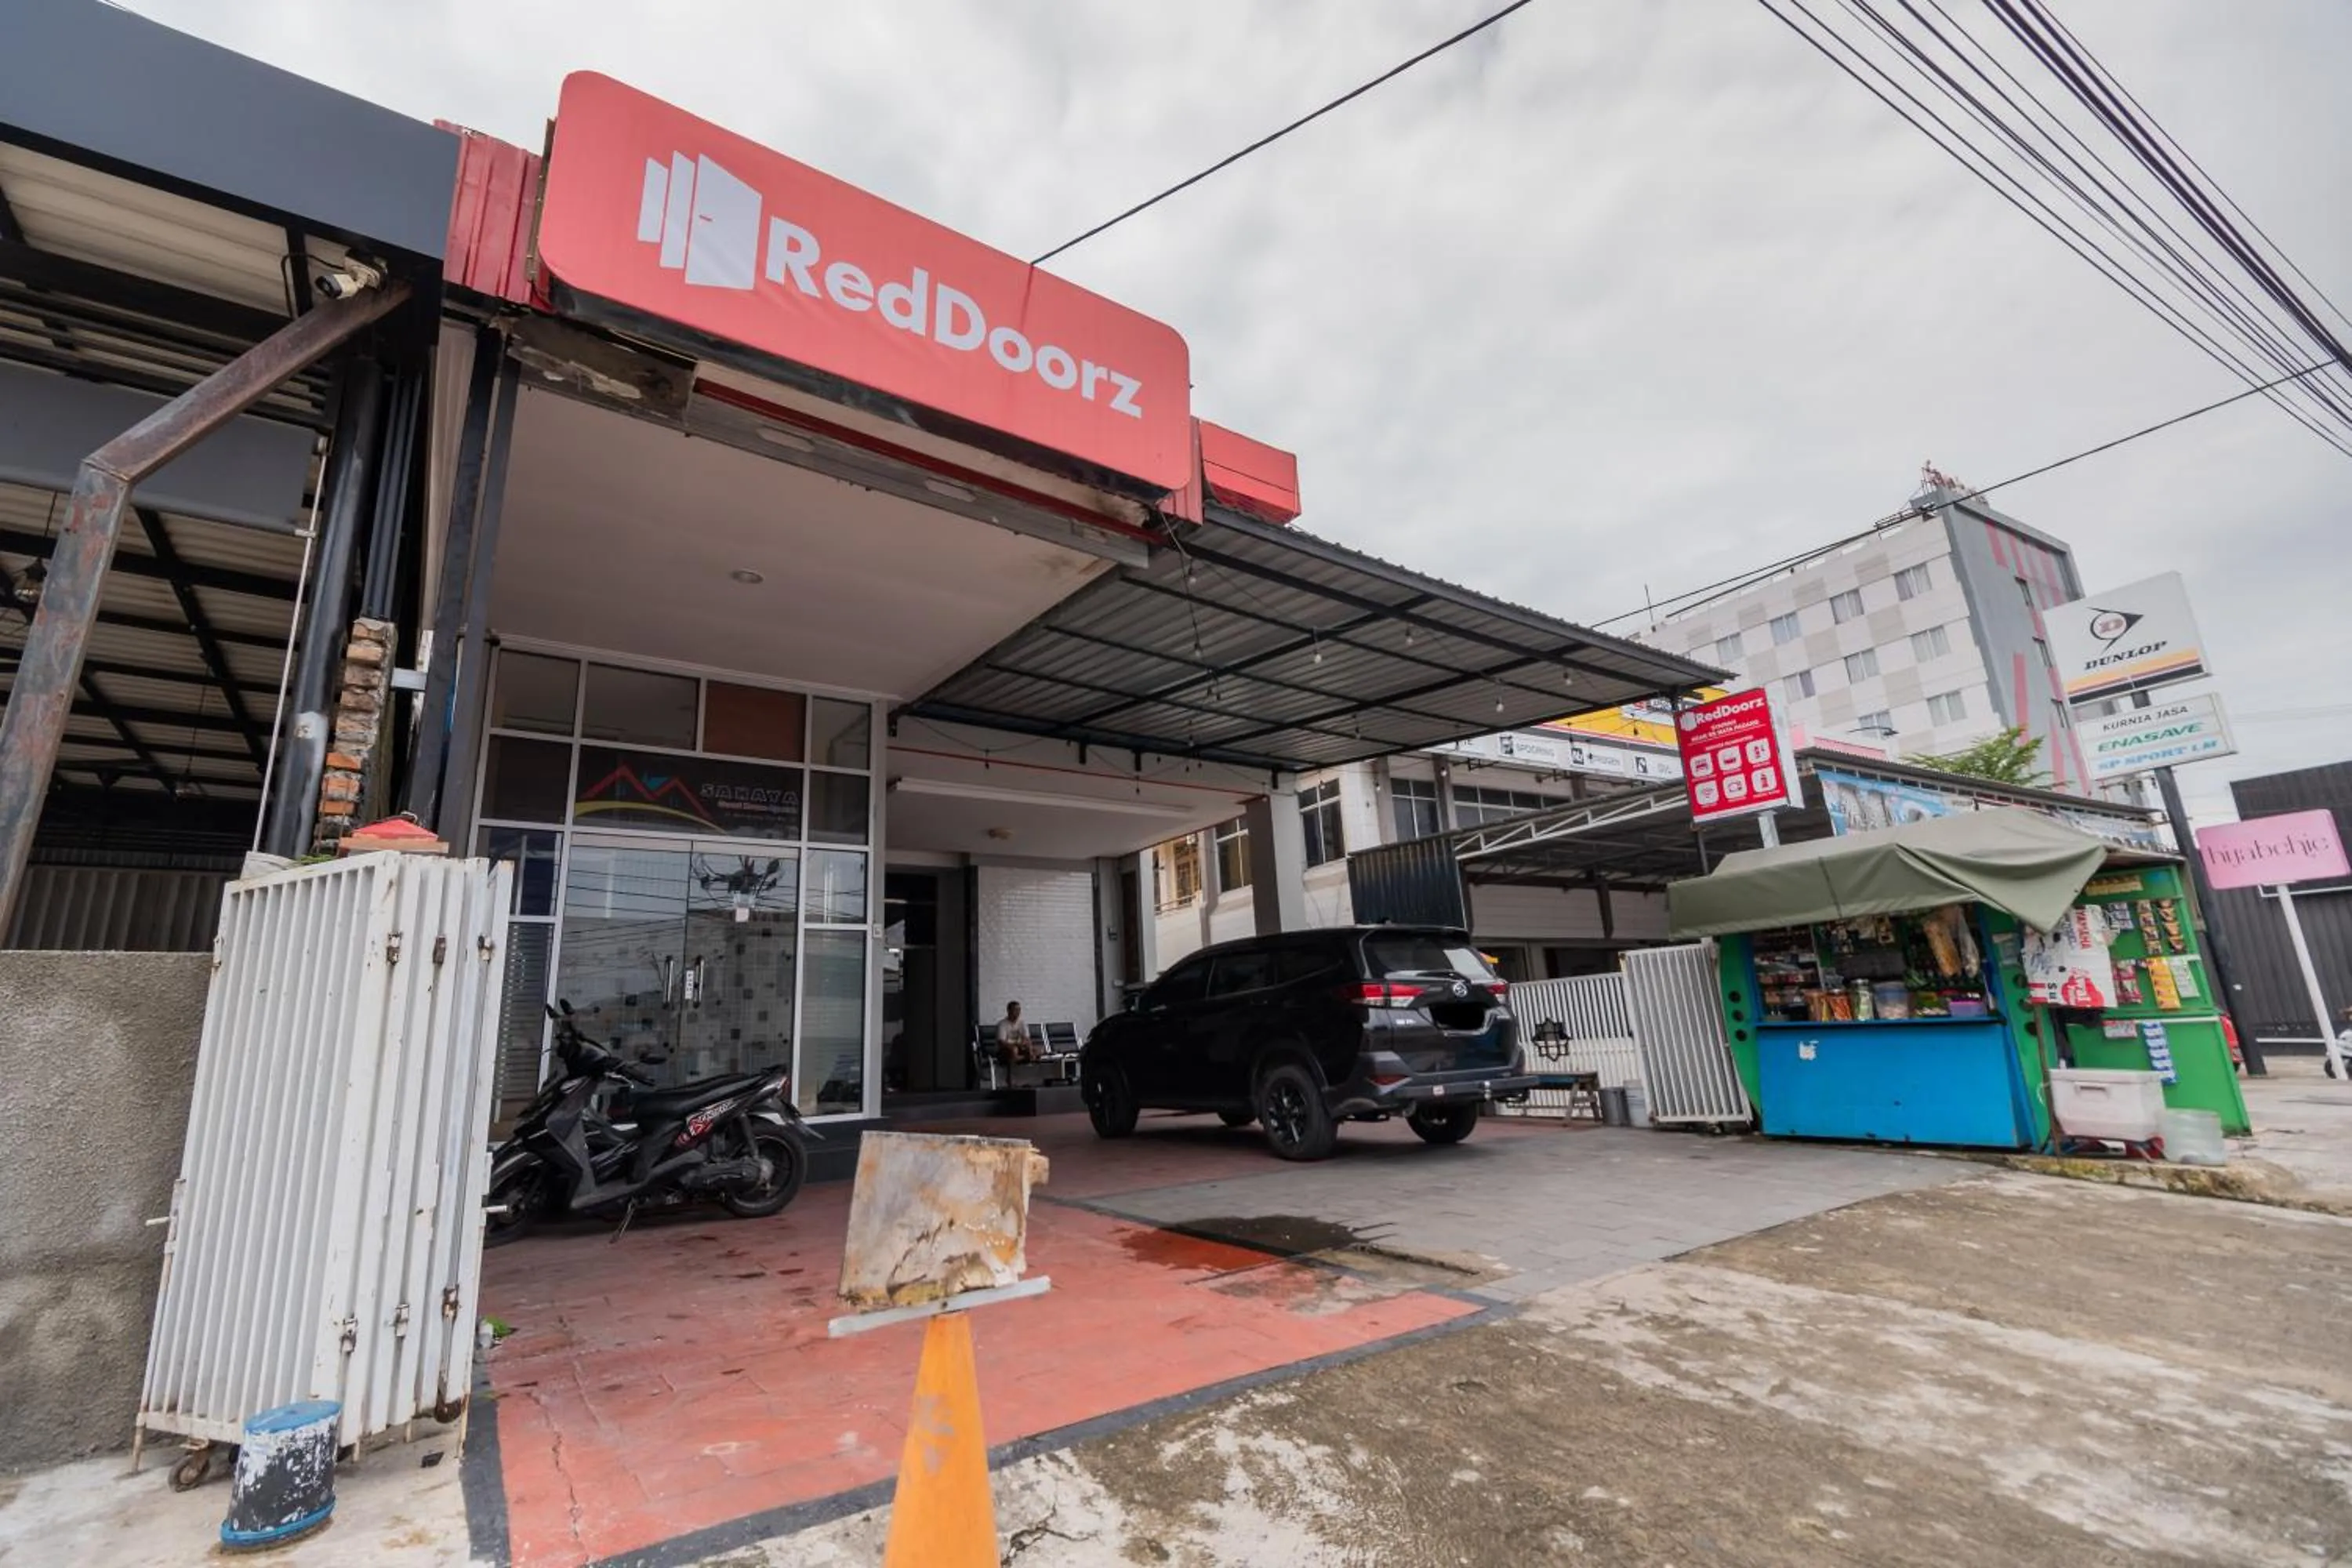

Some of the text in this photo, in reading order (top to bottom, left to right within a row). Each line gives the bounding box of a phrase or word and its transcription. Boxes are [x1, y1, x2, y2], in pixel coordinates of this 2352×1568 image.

[764, 216, 1142, 419] RedDoorz
[2085, 640, 2167, 670] DUNLOP
[1697, 697, 1765, 724] RedDoorz
[2103, 706, 2188, 731] KURNIA JASA
[2098, 722, 2204, 753] ENASAVE
[2125, 746, 2187, 765] SPORT
